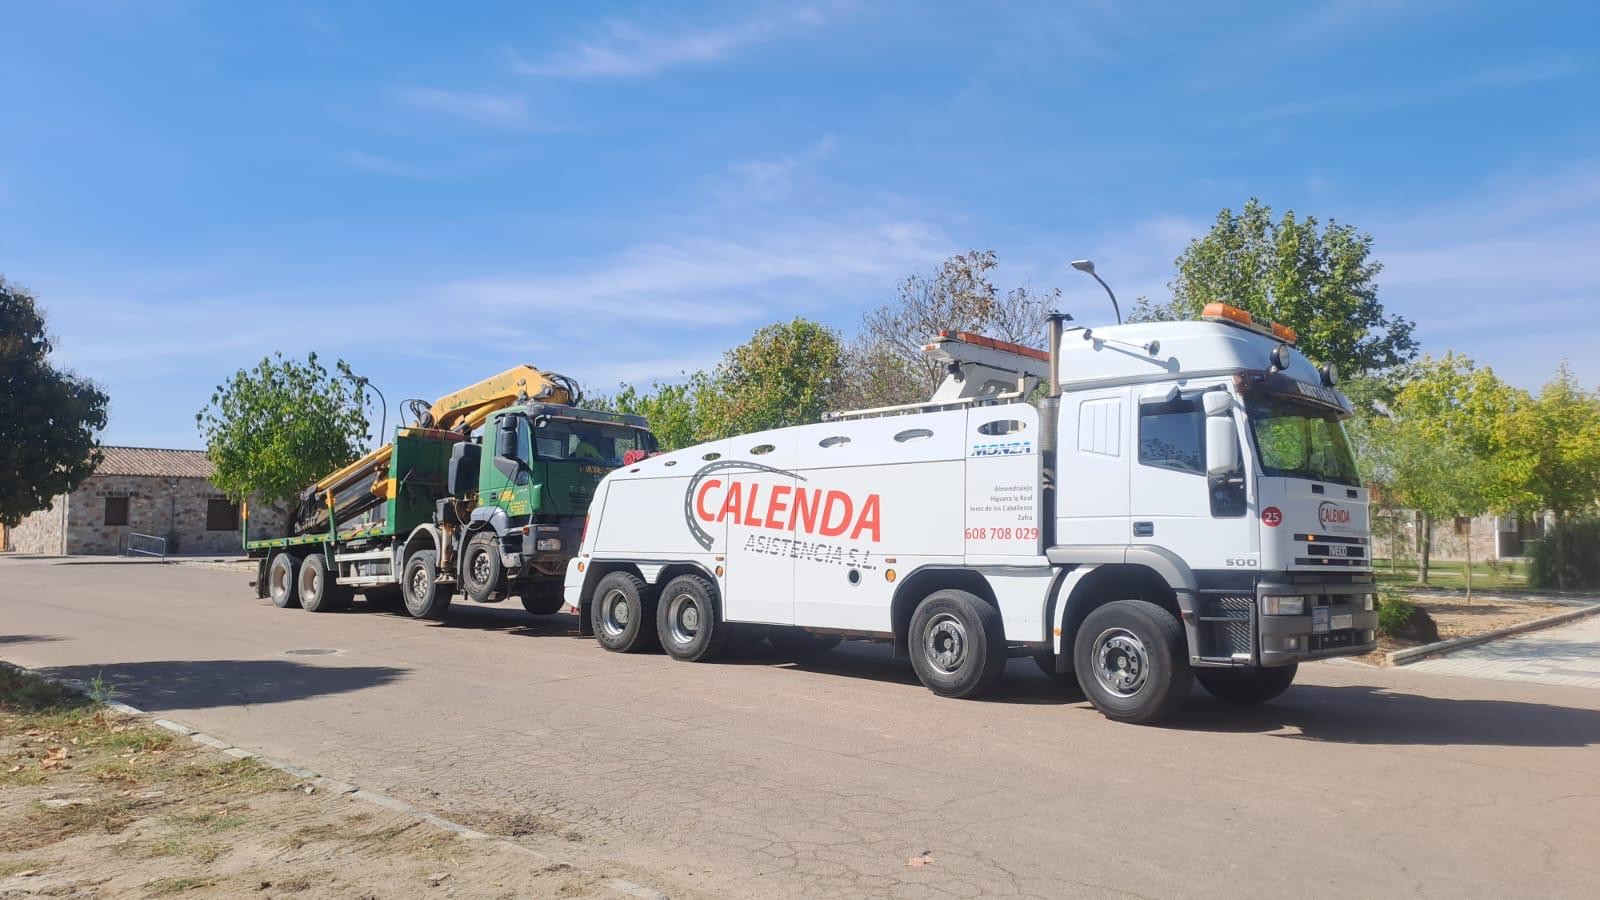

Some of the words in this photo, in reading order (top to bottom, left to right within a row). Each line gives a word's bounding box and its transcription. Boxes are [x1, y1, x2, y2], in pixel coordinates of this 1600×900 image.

[971, 441, 1031, 456] MONZA
[696, 479, 881, 543] CALENDA
[1265, 512, 1279, 523] 25
[1320, 507, 1350, 523] CALENDA
[964, 527, 986, 540] 608
[990, 527, 1012, 540] 708
[1015, 527, 1039, 540] 029
[743, 534, 843, 565] ASISTENCIA
[1329, 545, 1347, 557] IVECO
[1226, 558, 1257, 567] 500
